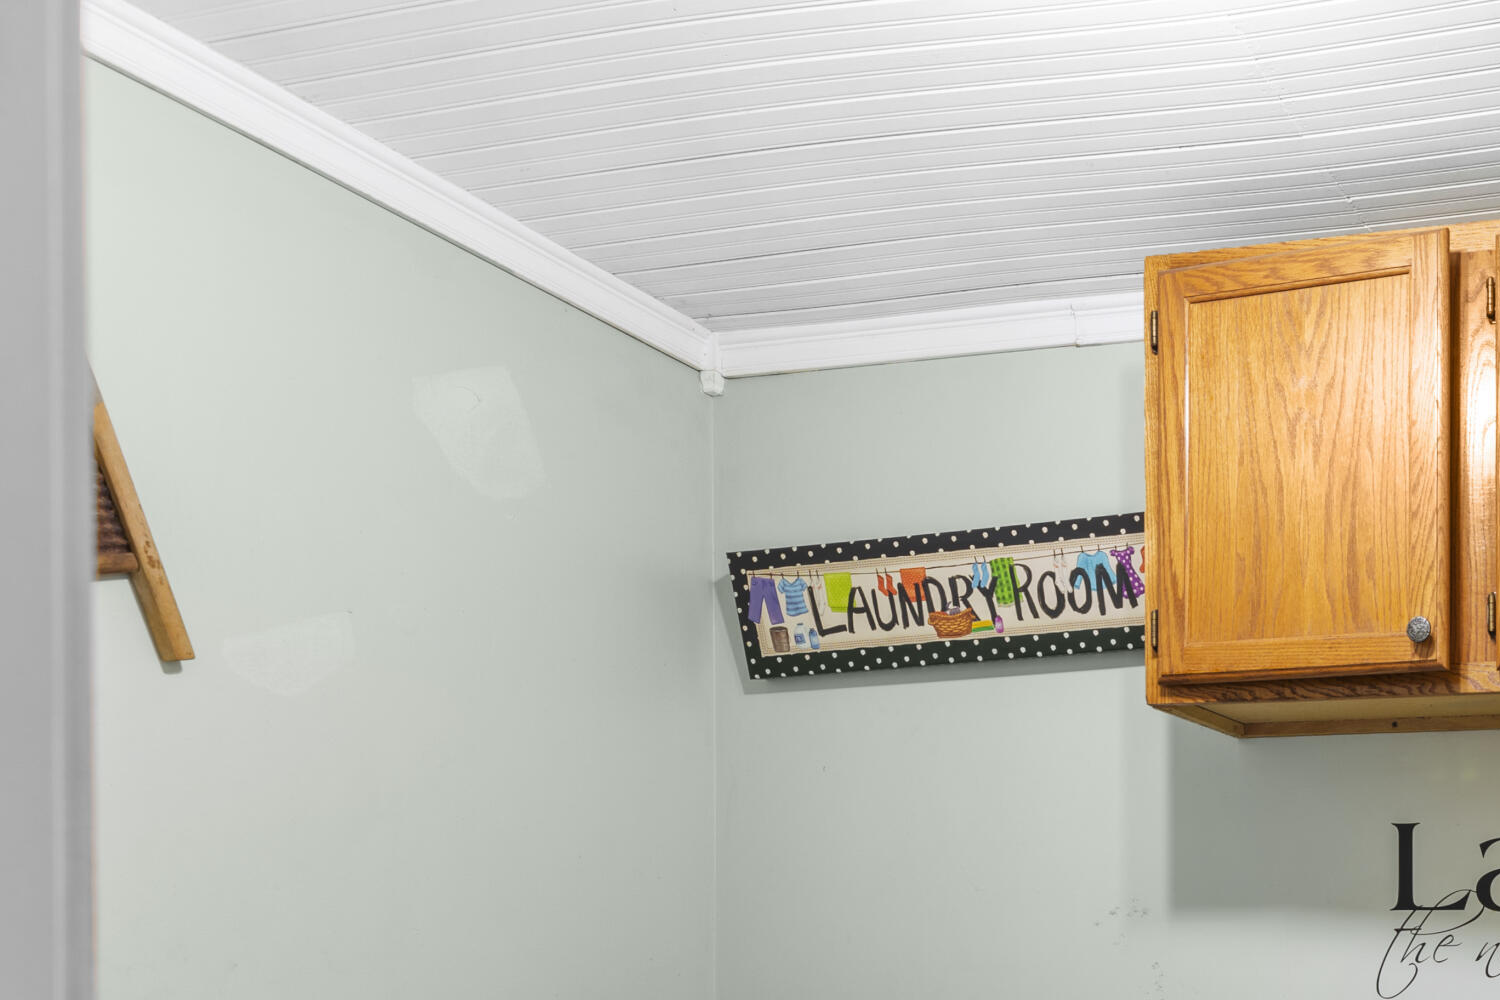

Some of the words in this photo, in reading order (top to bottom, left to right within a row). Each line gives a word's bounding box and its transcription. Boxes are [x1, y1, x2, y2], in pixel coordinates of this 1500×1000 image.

[808, 574, 998, 638] LAUNDRY
[1012, 562, 1140, 622] ROOM
[1376, 889, 1486, 999] the
